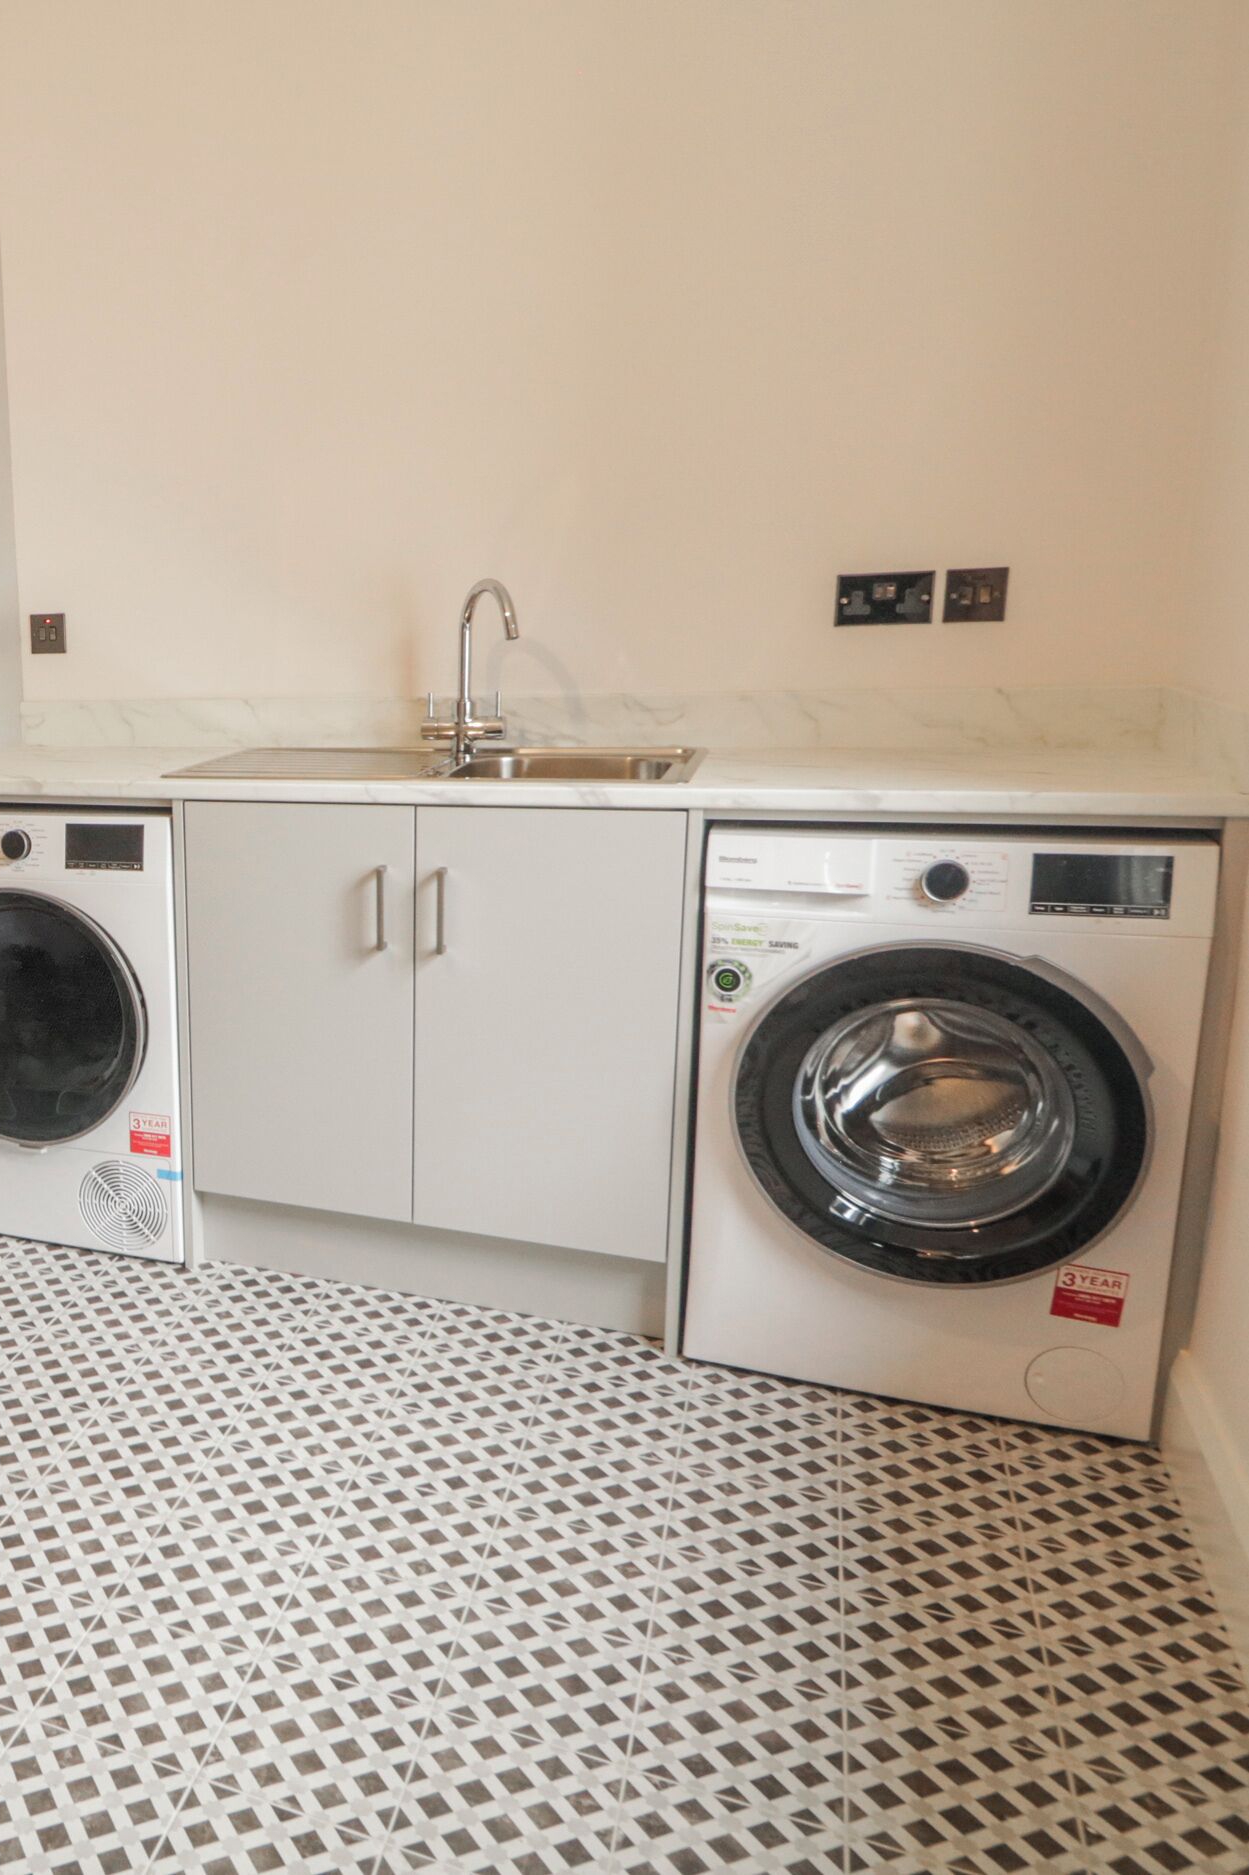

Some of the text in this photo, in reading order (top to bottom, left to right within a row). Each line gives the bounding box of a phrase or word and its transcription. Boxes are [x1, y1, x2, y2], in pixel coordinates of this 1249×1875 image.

[768, 940, 799, 949] SAVING
[132, 1118, 168, 1130] 3 YEAR
[1062, 1272, 1122, 1290] 3 YEAR
